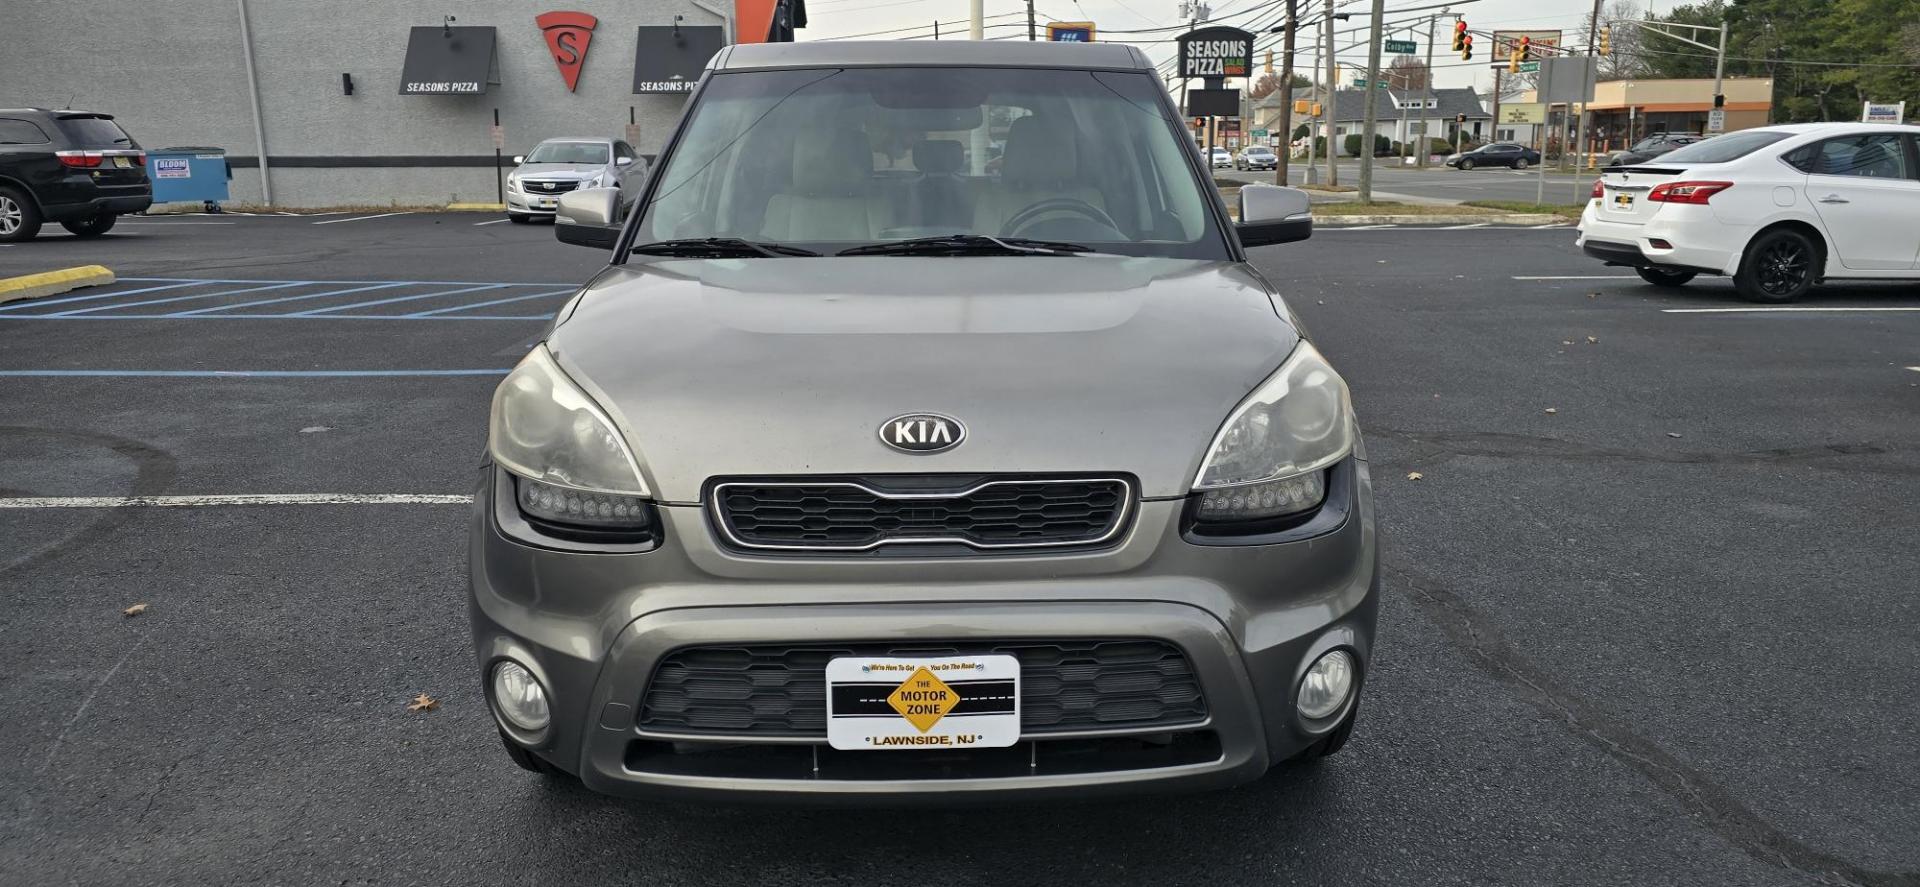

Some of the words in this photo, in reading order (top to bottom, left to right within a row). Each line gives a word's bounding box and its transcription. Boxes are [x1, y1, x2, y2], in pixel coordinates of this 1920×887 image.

[557, 31, 579, 65] S
[1187, 40, 1246, 57] SEASONS
[1186, 58, 1224, 75] PIZZA
[406, 82, 450, 92] SEASONS
[451, 82, 478, 92] PIZZA
[640, 81, 683, 91] SEASONS
[895, 421, 952, 444] KIA
[900, 690, 947, 701] MOTOR
[906, 704, 941, 715] ZONE
[873, 735, 953, 746] LAWNSIDE,
[957, 735, 975, 744] NJ
